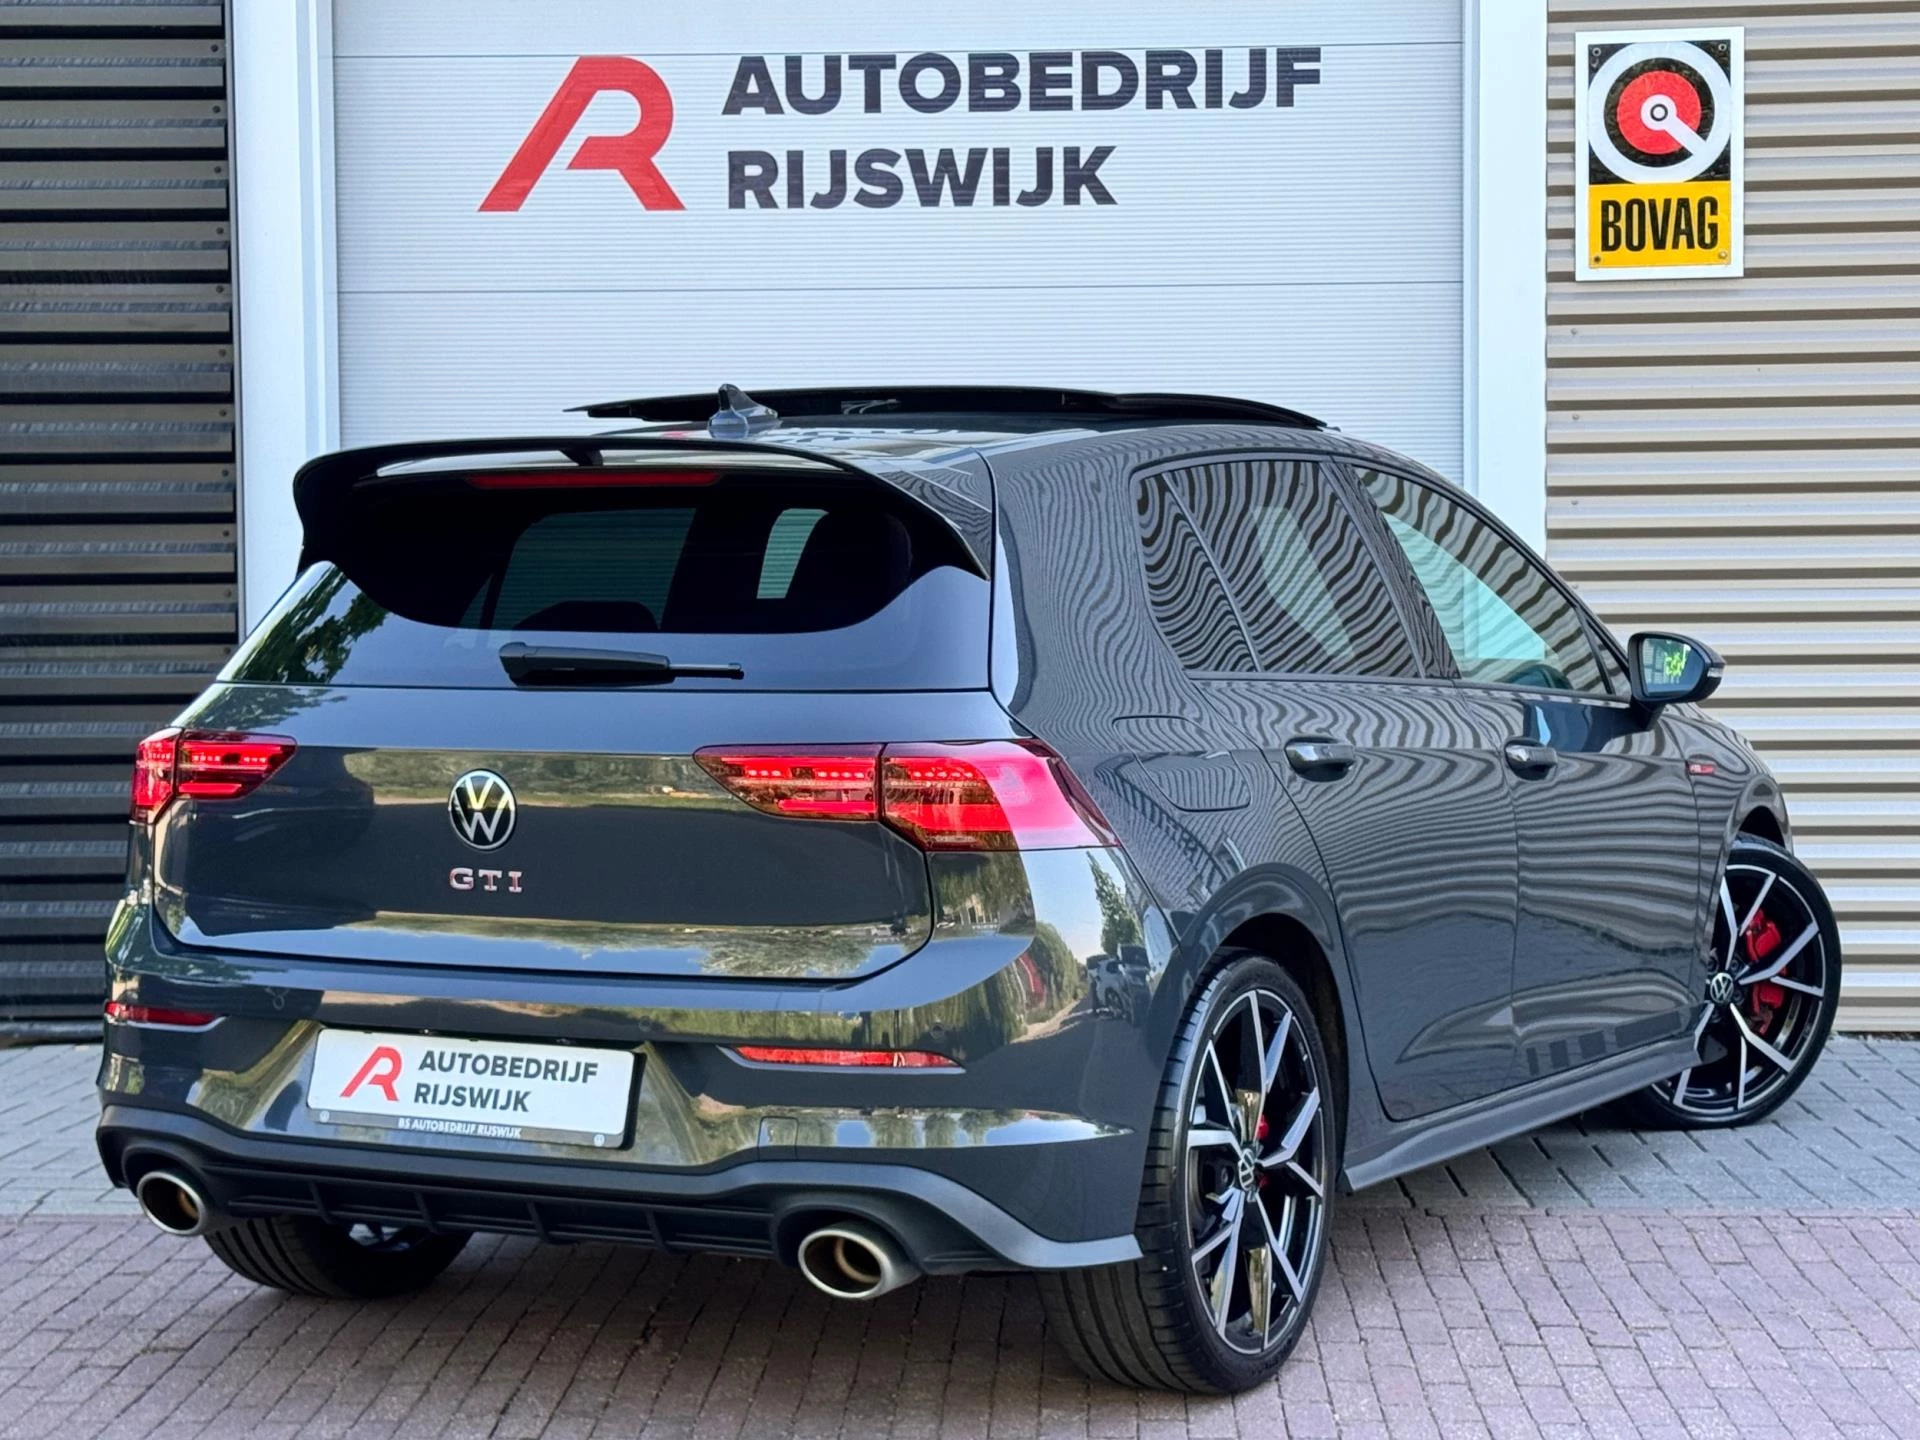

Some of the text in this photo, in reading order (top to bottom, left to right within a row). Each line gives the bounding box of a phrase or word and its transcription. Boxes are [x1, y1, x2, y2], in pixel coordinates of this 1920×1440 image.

[722, 47, 1321, 116] AUTOBEDRIJF
[728, 146, 1118, 210] RIJSWIJK
[1600, 196, 1718, 252] BOVAG
[449, 867, 523, 893] GTI
[418, 1049, 599, 1084] AUTOBEDRIJF
[413, 1082, 532, 1113] RIJSWIJK
[398, 1117, 522, 1139] BS AUTOBEDRIJF RIJSWIJK
